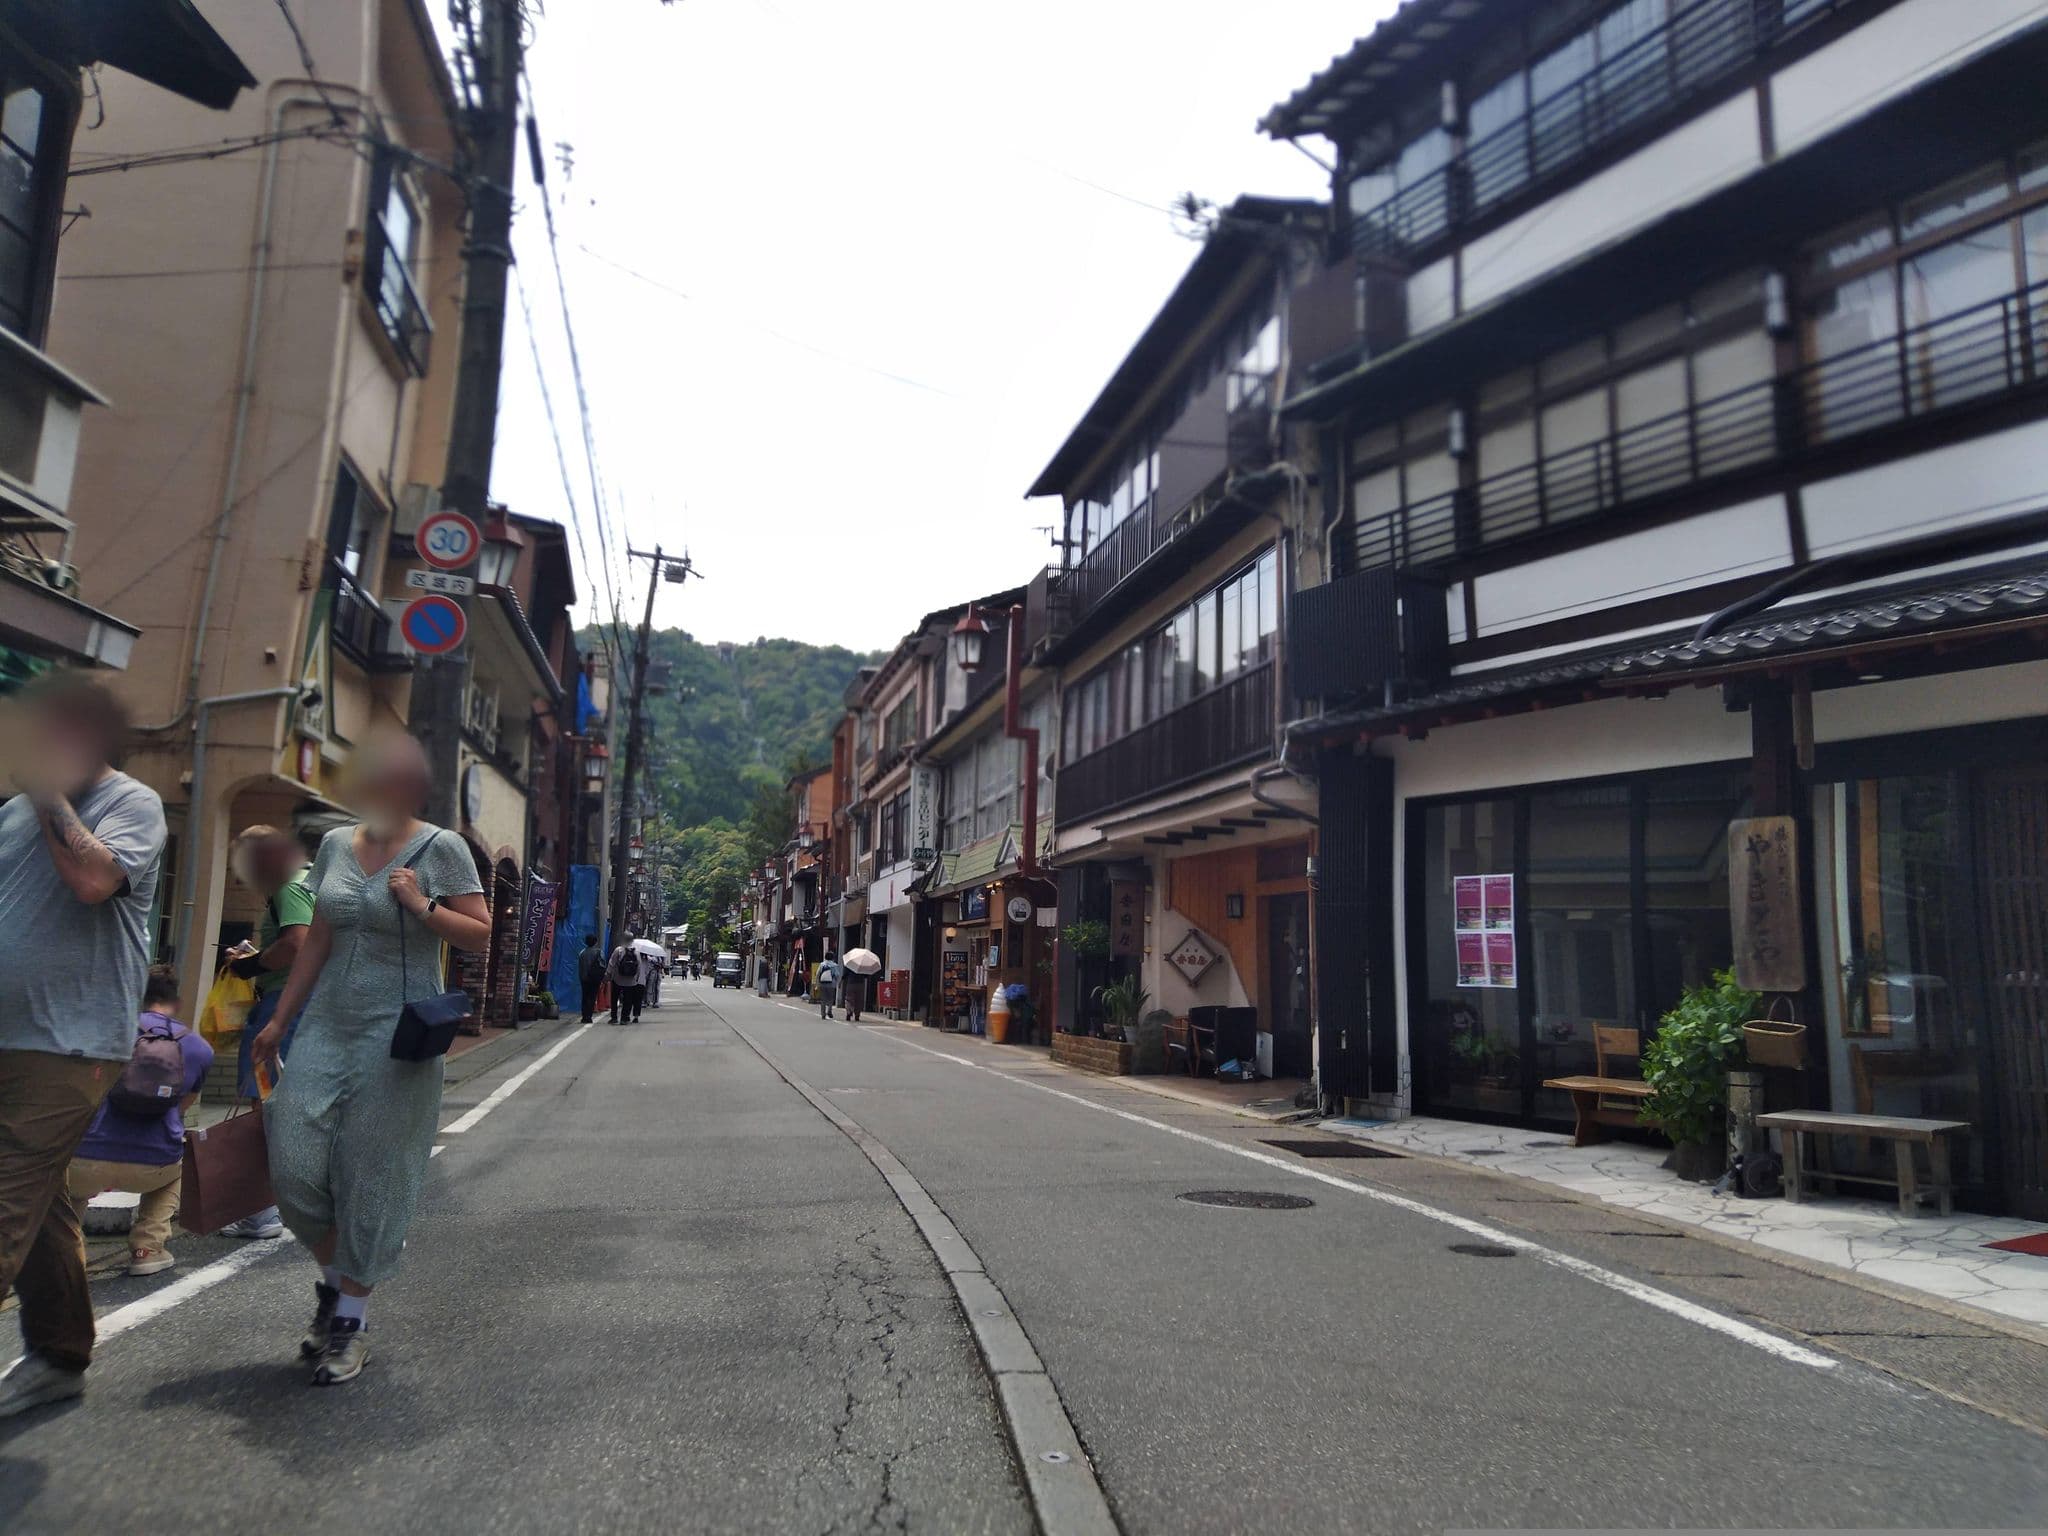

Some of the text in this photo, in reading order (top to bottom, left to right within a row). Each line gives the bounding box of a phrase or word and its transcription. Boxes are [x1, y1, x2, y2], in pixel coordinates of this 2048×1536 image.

[431, 527, 468, 554] 30
[411, 572, 467, 594] 区域内
